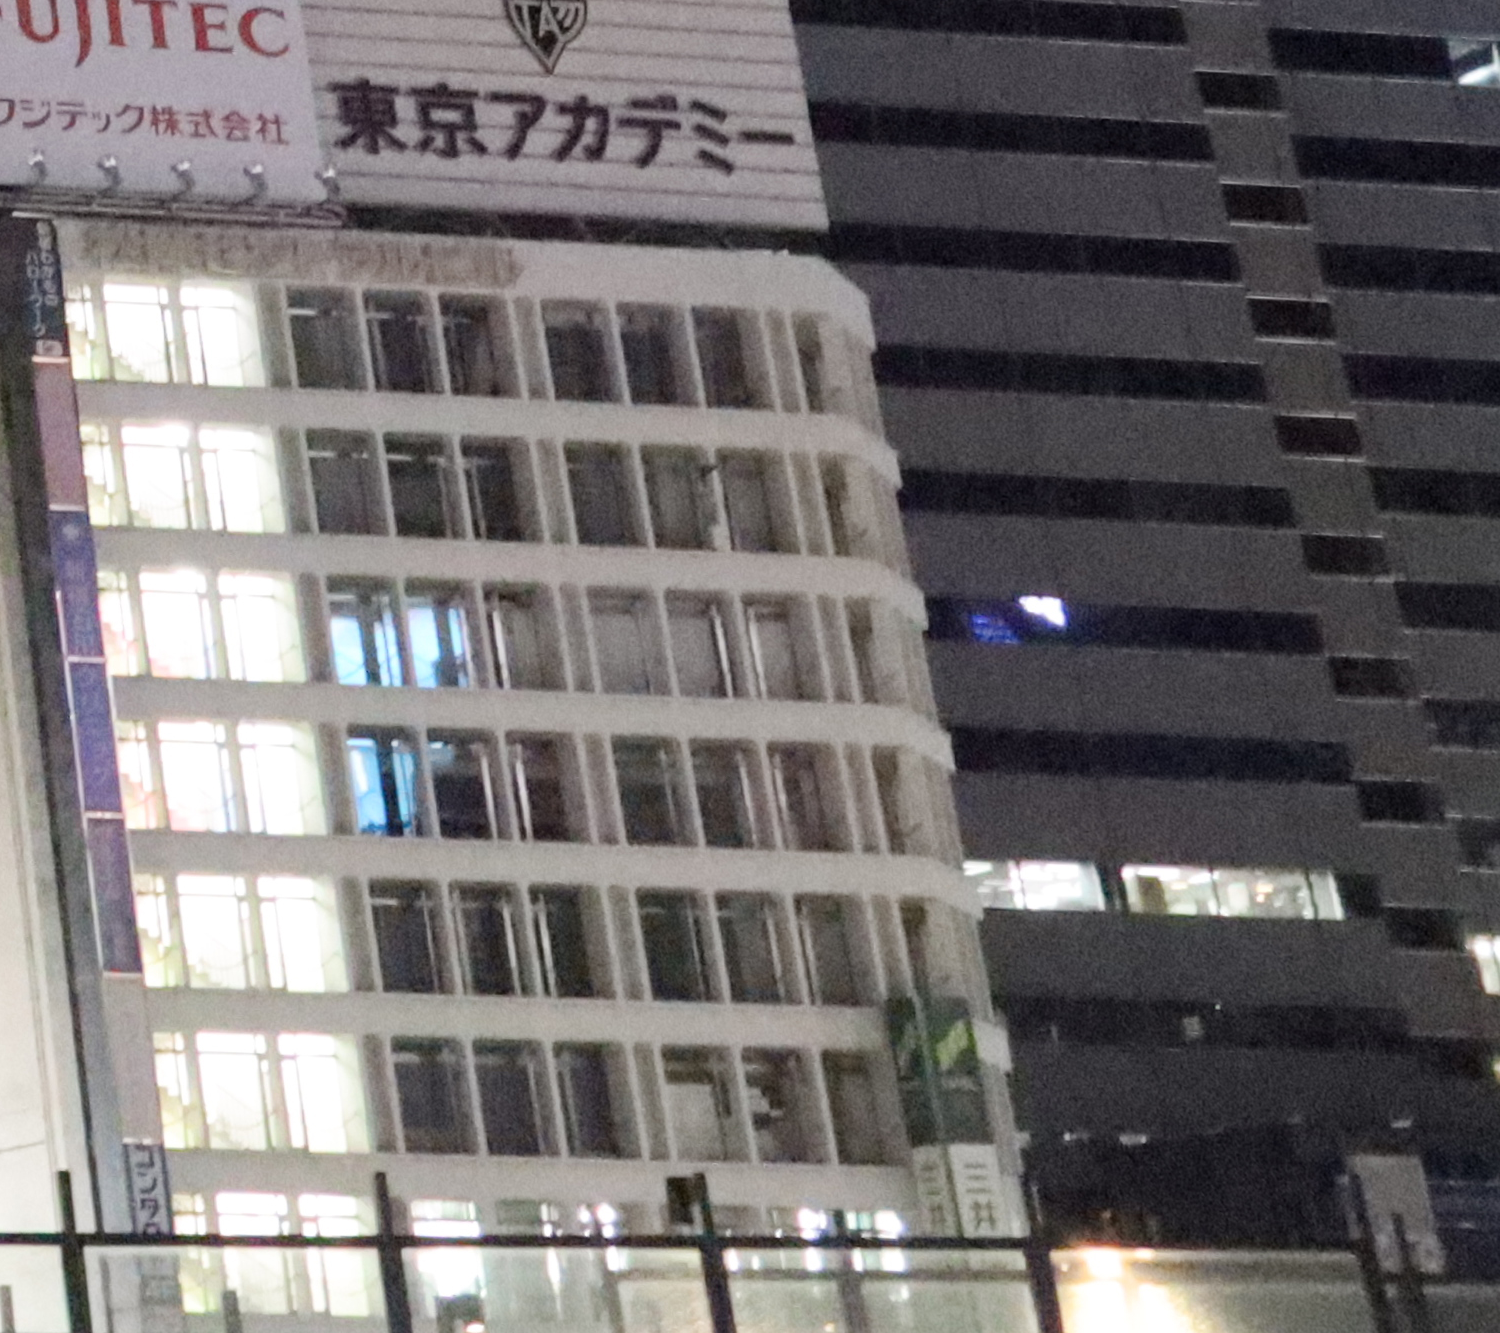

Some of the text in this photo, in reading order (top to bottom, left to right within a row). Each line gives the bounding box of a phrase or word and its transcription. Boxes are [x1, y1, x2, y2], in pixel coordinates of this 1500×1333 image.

[327, 78, 795, 176] 東京アカデミー
